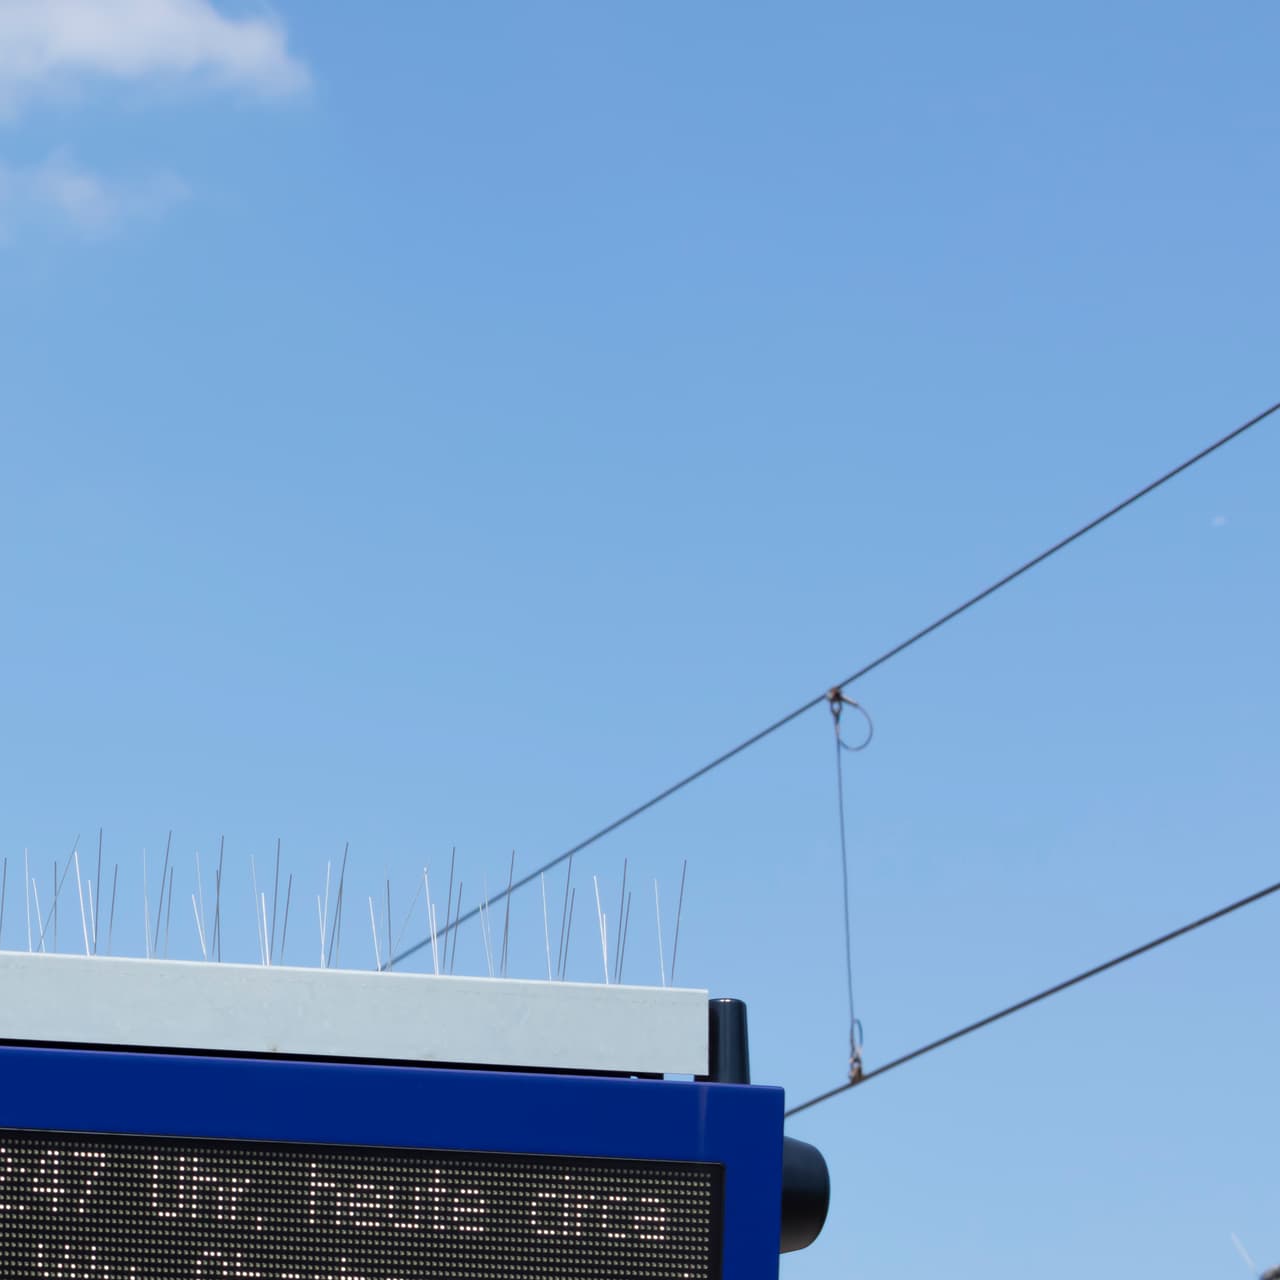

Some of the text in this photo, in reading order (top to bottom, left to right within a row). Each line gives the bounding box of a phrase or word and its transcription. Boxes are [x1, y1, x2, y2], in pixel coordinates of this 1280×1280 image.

[151, 1154, 263, 1231] Uhr,
[308, 1162, 486, 1232] heute
[530, 1173, 666, 1240] circa
